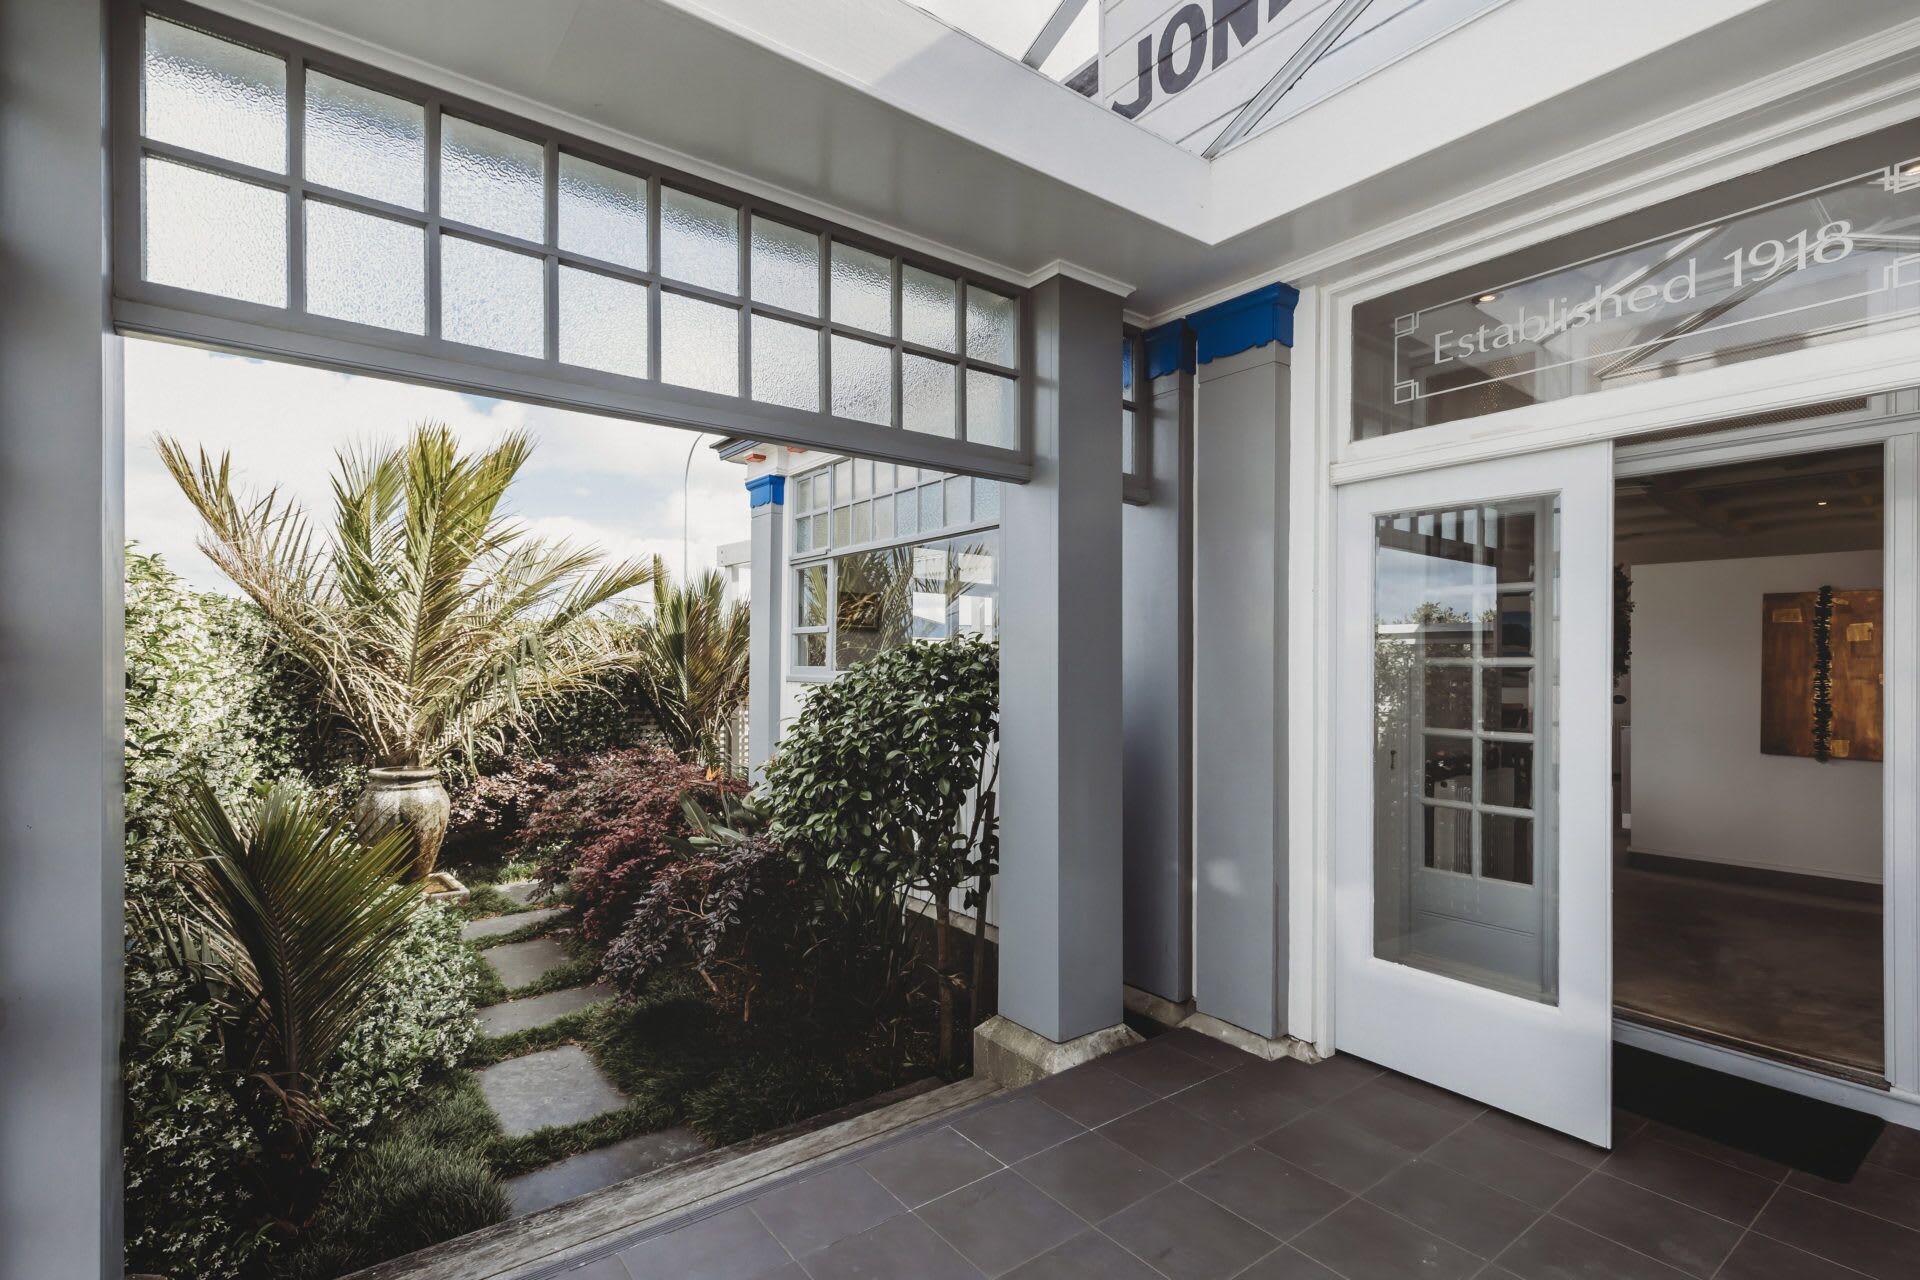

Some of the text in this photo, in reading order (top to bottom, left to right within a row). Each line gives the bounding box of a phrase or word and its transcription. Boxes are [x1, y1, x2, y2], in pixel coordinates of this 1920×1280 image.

[1111, 0, 1293, 120] JON
[1434, 220, 1854, 365] Established 1918
